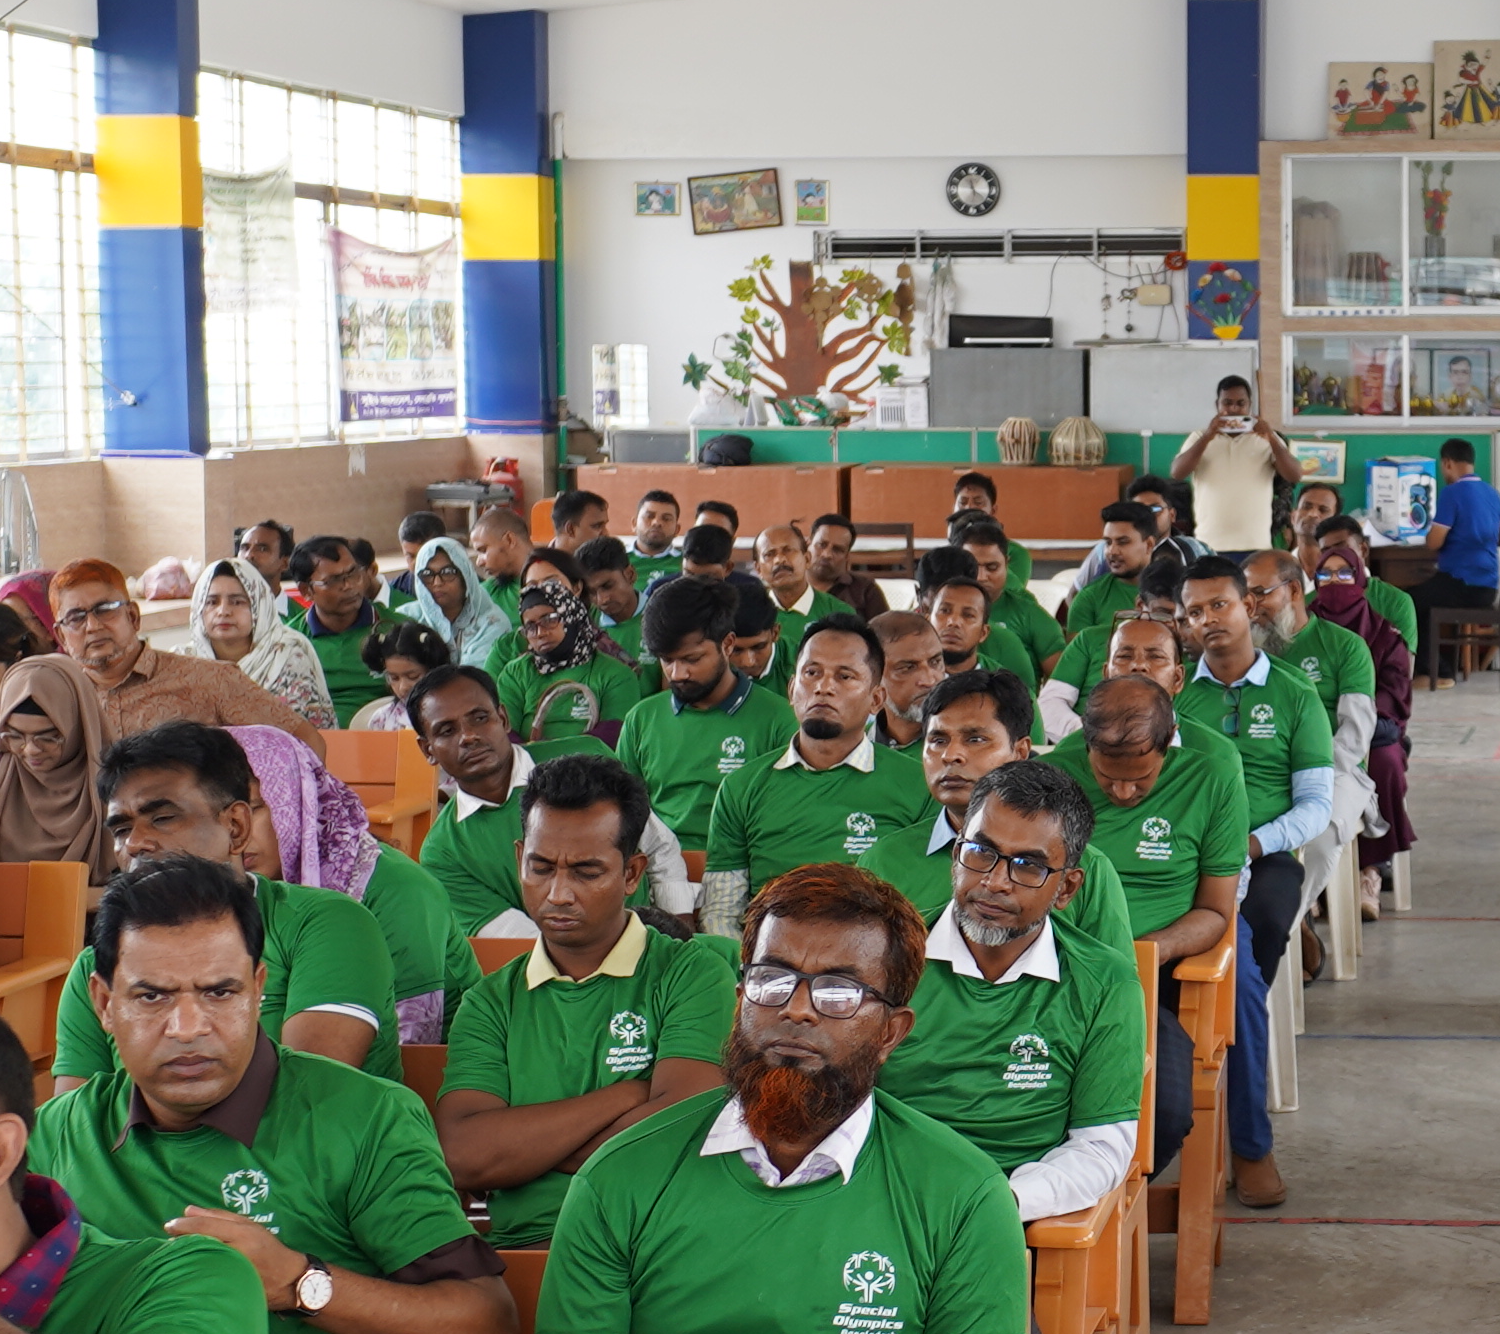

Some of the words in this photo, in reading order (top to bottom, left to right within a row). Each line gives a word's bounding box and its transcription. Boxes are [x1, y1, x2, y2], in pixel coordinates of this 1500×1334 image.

[1007, 1063, 1050, 1072] Special
[1002, 1072, 1052, 1082] Olympics
[838, 1303, 898, 1317] Special
[832, 1315, 904, 1331] Olympics
